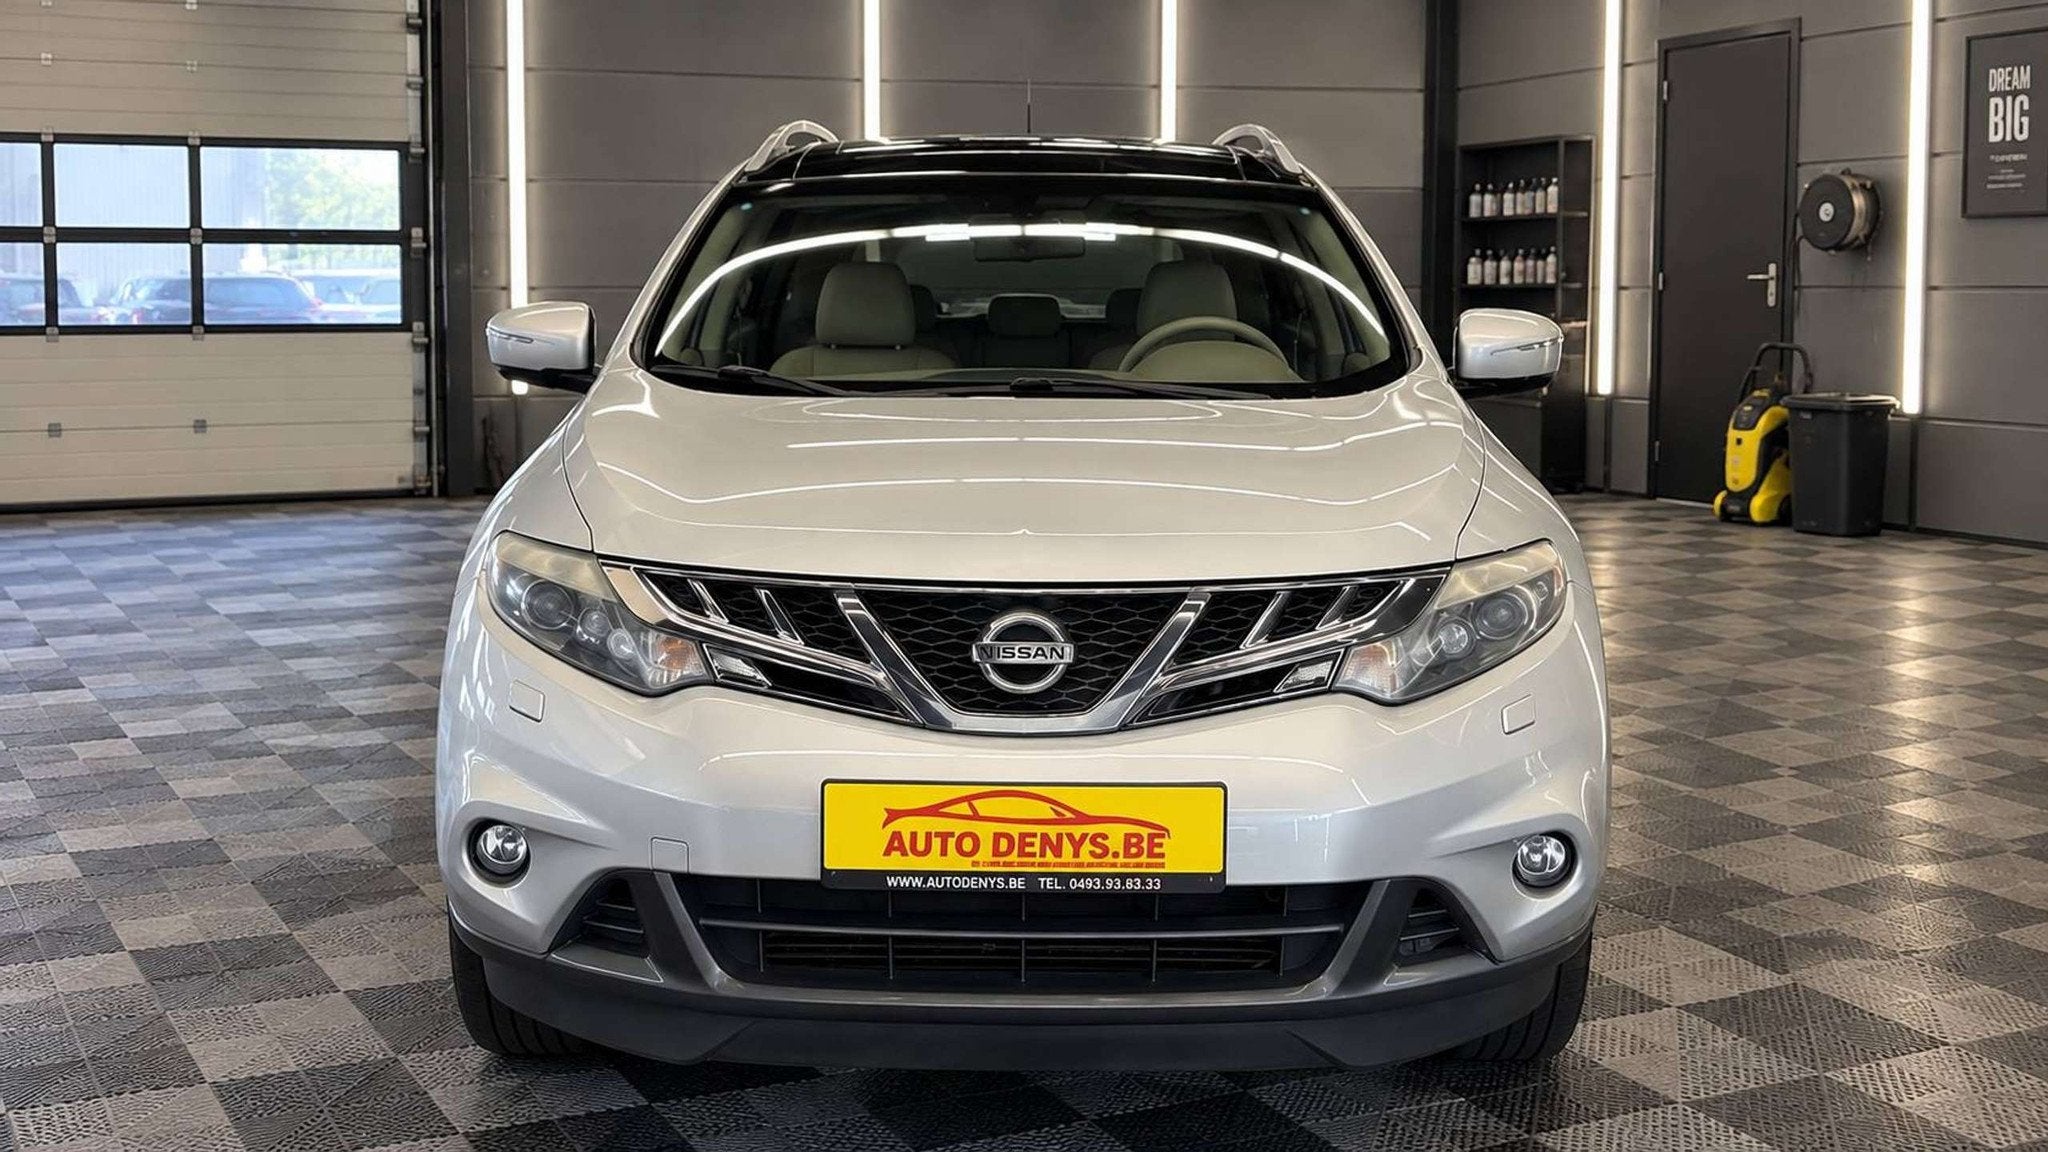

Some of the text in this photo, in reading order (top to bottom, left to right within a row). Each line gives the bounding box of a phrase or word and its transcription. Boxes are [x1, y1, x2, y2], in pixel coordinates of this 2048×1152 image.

[1988, 65, 2031, 93] DREAM
[1988, 94, 2030, 143] BIG
[979, 646, 1065, 660] NISSAN
[882, 831, 1166, 859] AUTO DENYS.BE
[886, 875, 1026, 890] WWW.AUTODENYS.BE
[1038, 877, 1066, 891] TEL.
